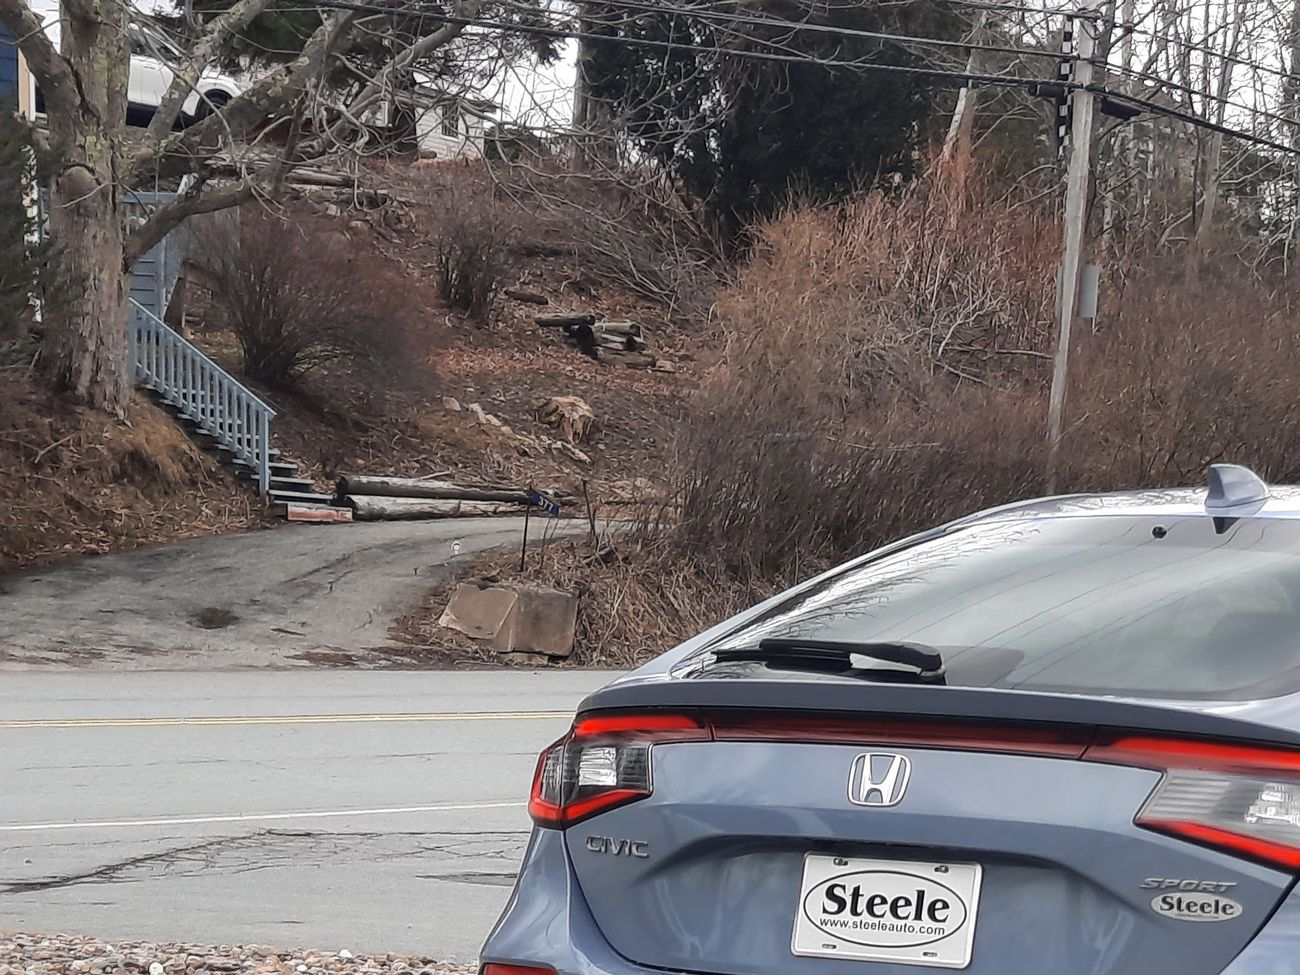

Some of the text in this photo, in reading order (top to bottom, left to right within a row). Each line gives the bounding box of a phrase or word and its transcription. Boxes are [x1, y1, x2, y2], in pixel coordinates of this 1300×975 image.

[538, 496, 554, 511] 377
[586, 835, 650, 858] CIVIC
[1140, 877, 1238, 892] SPORT
[822, 883, 951, 923] Steele
[1160, 896, 1235, 915] Steele
[820, 917, 946, 936] www.steeleauto.com
